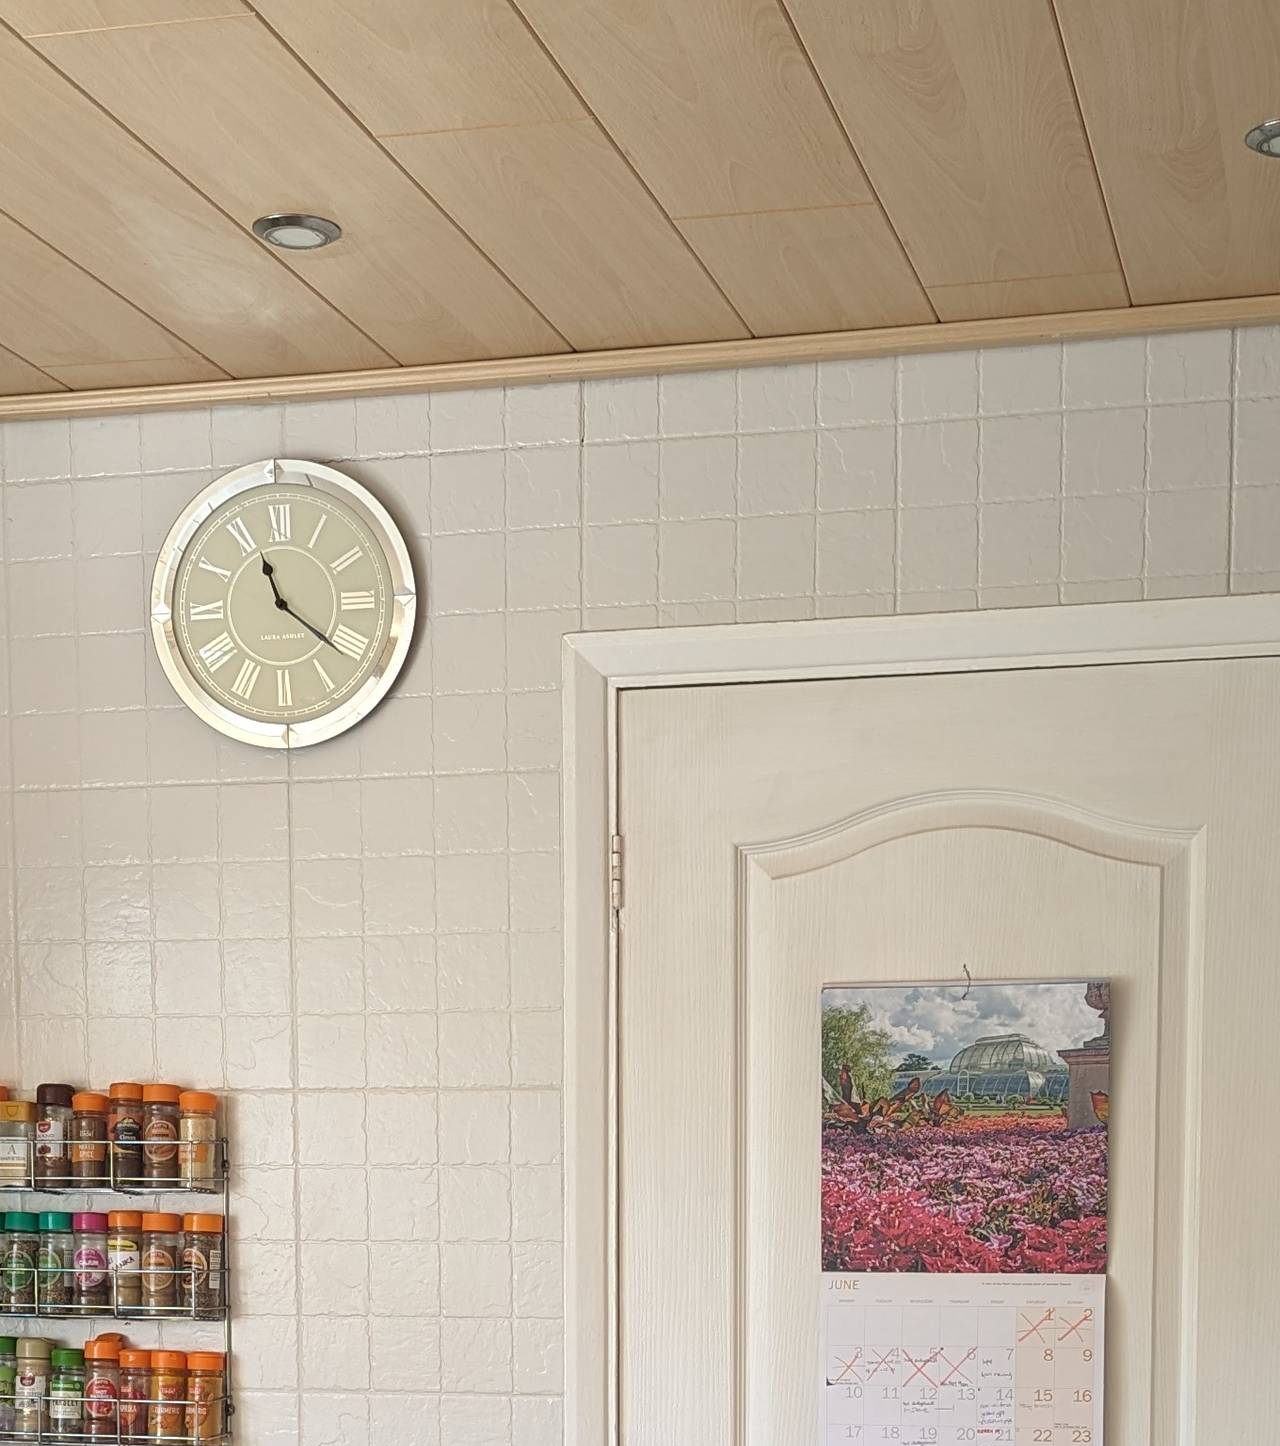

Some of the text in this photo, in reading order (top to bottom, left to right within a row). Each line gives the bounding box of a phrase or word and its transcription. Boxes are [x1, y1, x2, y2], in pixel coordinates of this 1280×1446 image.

[226, 516, 257, 557] XI
[268, 504, 291, 542] XII
[308, 513, 327, 549] I
[198, 556, 232, 583] X
[329, 546, 363, 575] II
[190, 600, 224, 621] IX
[340, 590, 375, 610] III
[197, 631, 237, 673] VIII
[230, 658, 261, 700] VII
[276, 669, 293, 706] VI
[312, 658, 335, 692] V
[828, 1279, 860, 1290] JUNE
[1006, 1348, 1014, 1360] 7
[1043, 1349, 1054, 1361] 8
[1082, 1349, 1093, 1361] 9
[845, 1386, 863, 1399] 10
[882, 1387, 900, 1399] 11
[957, 1388, 976, 1401] 13
[996, 1388, 1013, 1401] 14
[1034, 1389, 1053, 1402] 15
[1073, 1390, 1092, 1402] 16
[845, 1426, 862, 1438] 17
[881, 1426, 900, 1439] 18
[919, 1427, 938, 1440] 19
[956, 1427, 976, 1441] 20
[995, 1429, 1013, 1441] 21
[1033, 1429, 1053, 1442] 22
